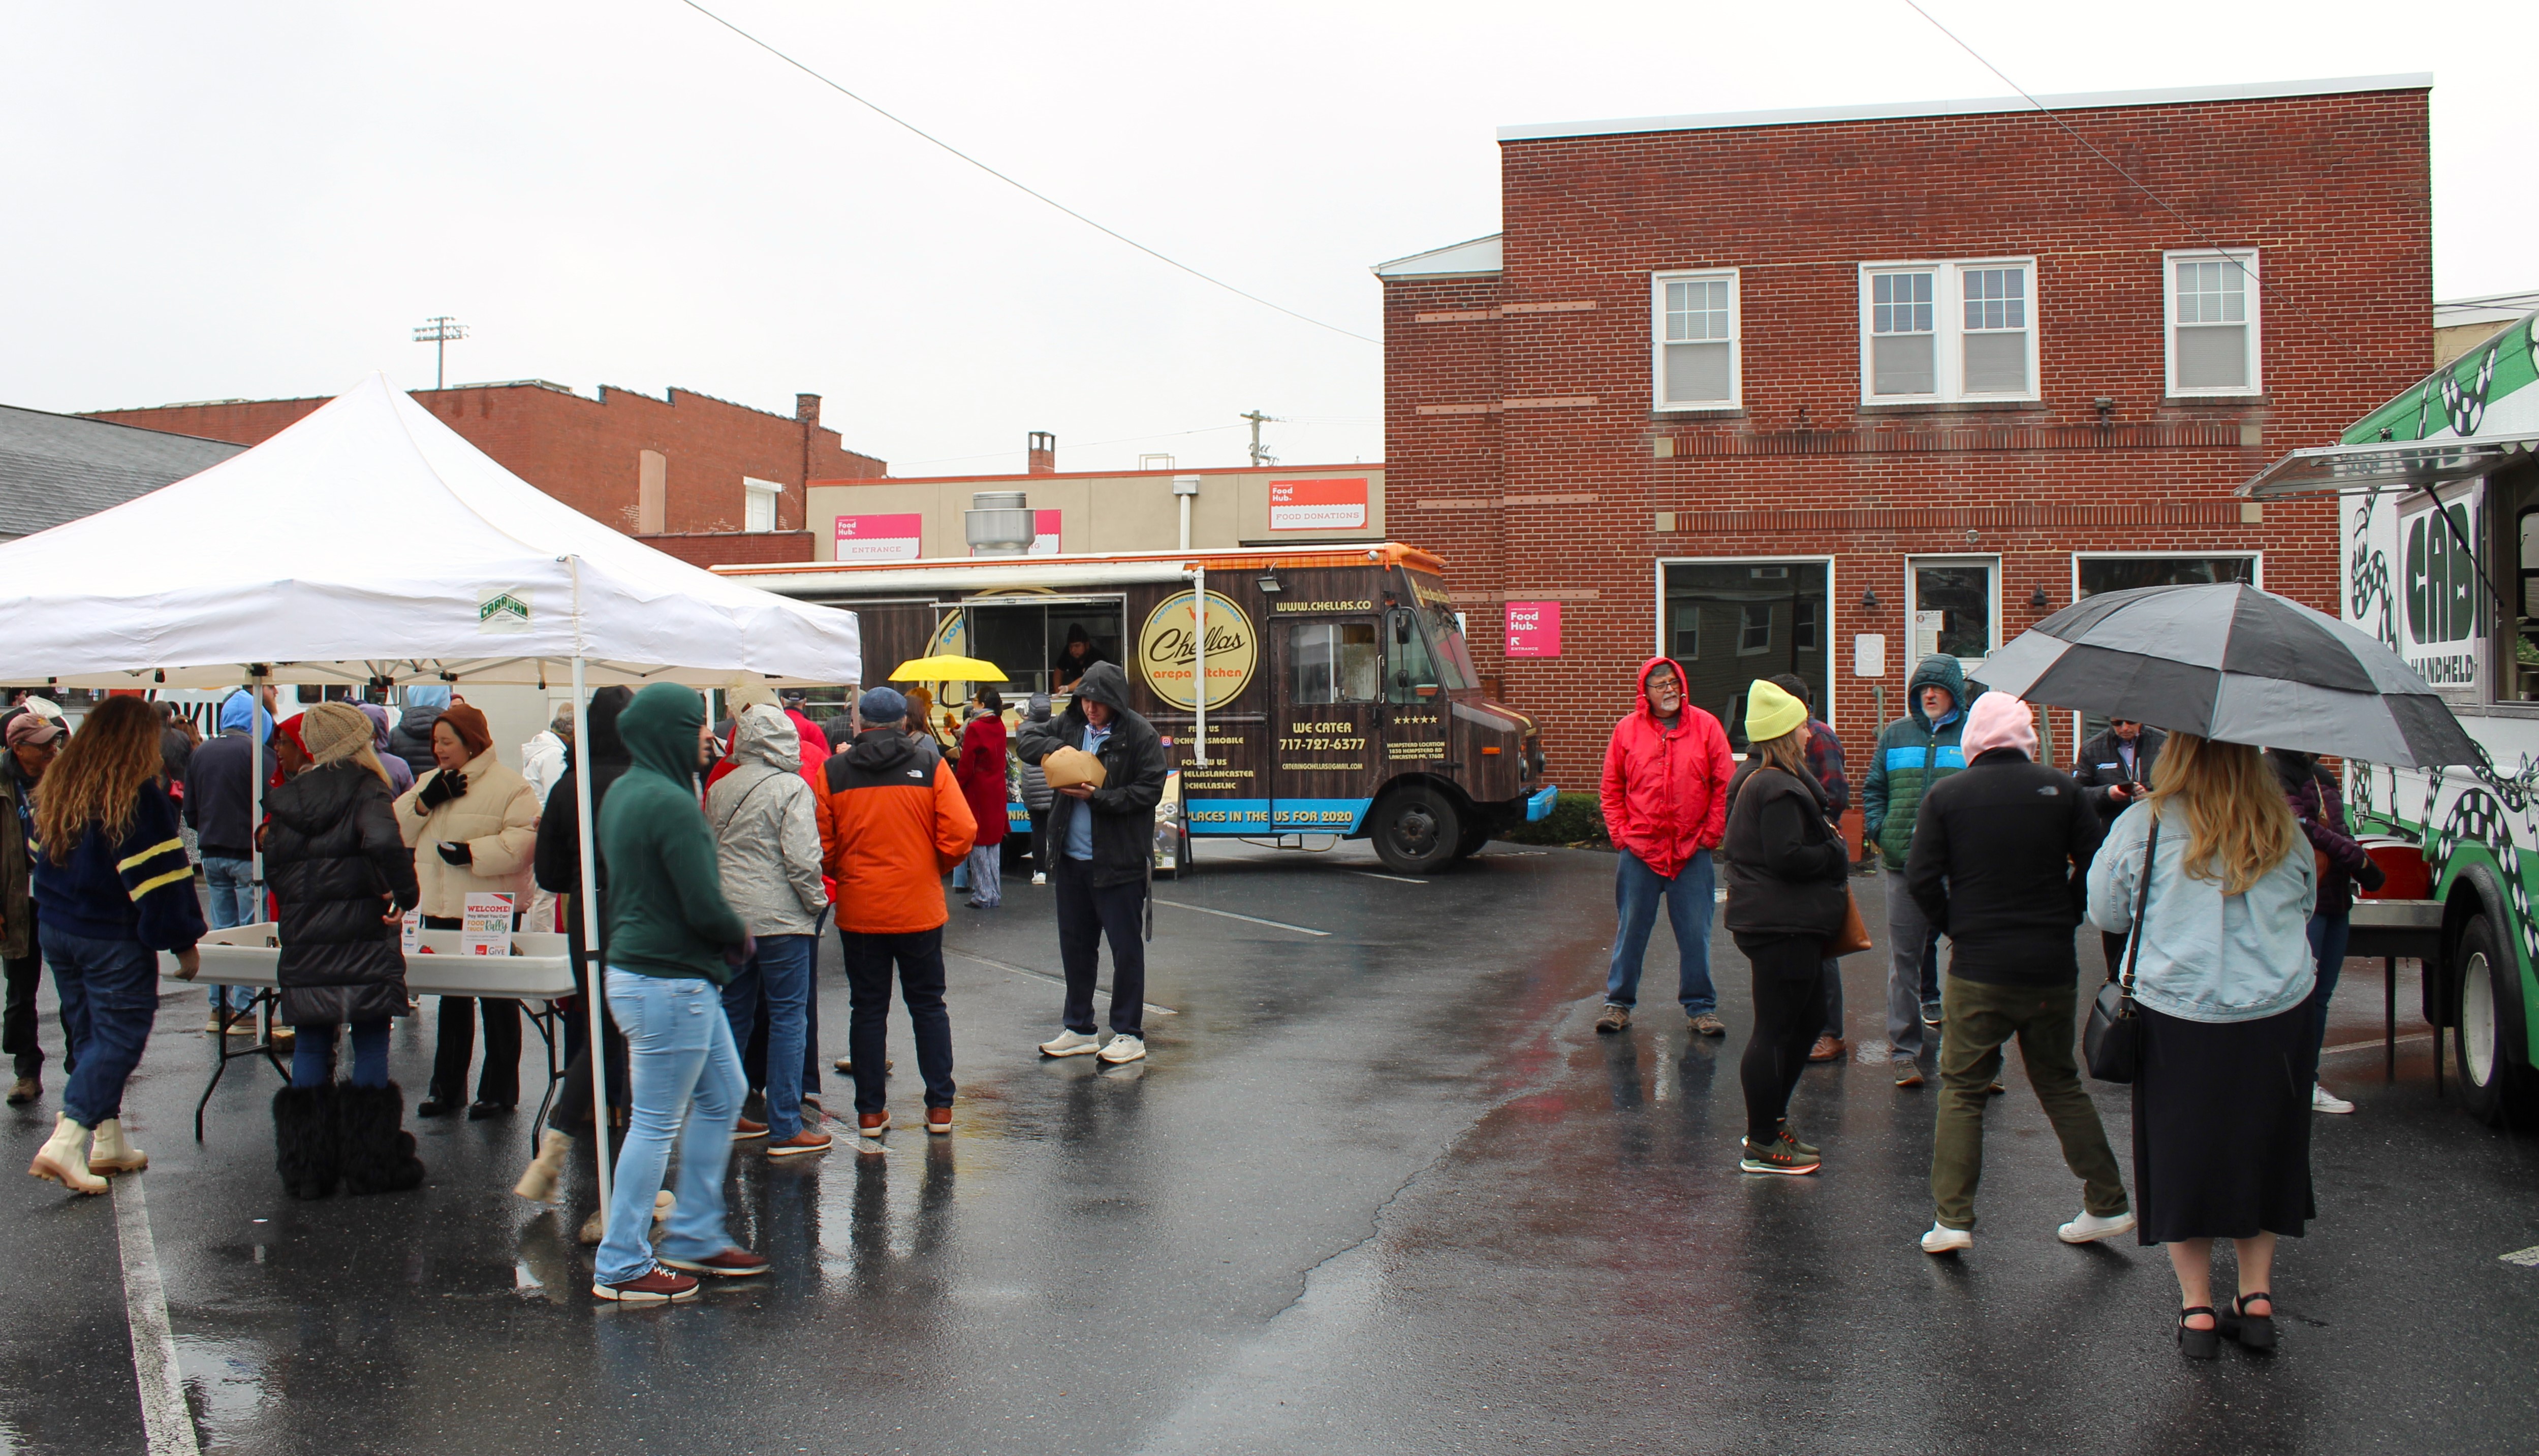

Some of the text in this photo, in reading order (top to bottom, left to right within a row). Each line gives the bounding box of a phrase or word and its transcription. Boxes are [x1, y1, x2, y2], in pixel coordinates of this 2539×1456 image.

[481, 596, 528, 619] CARAVAN
[1153, 596, 1240, 624] SOUTH AMERIN INSPIRED
[1276, 600, 1371, 612] WWW.CHELLAS.CO
[1511, 611, 1539, 620] Food
[943, 618, 963, 645] SOU
[1511, 621, 1538, 630] Hub.
[1149, 625, 1246, 661] Chellas
[1153, 668, 1242, 680] arepa itchen
[1293, 722, 1352, 733] WE CATER
[1279, 738, 1365, 750] 717-727-6377
[1229, 811, 1242, 822] IN
[1246, 811, 1268, 822] THE
[1274, 811, 1290, 822] US
[1293, 811, 1318, 822] FOR
[1322, 811, 1353, 822] 2020
[485, 919, 507, 934] Rally
